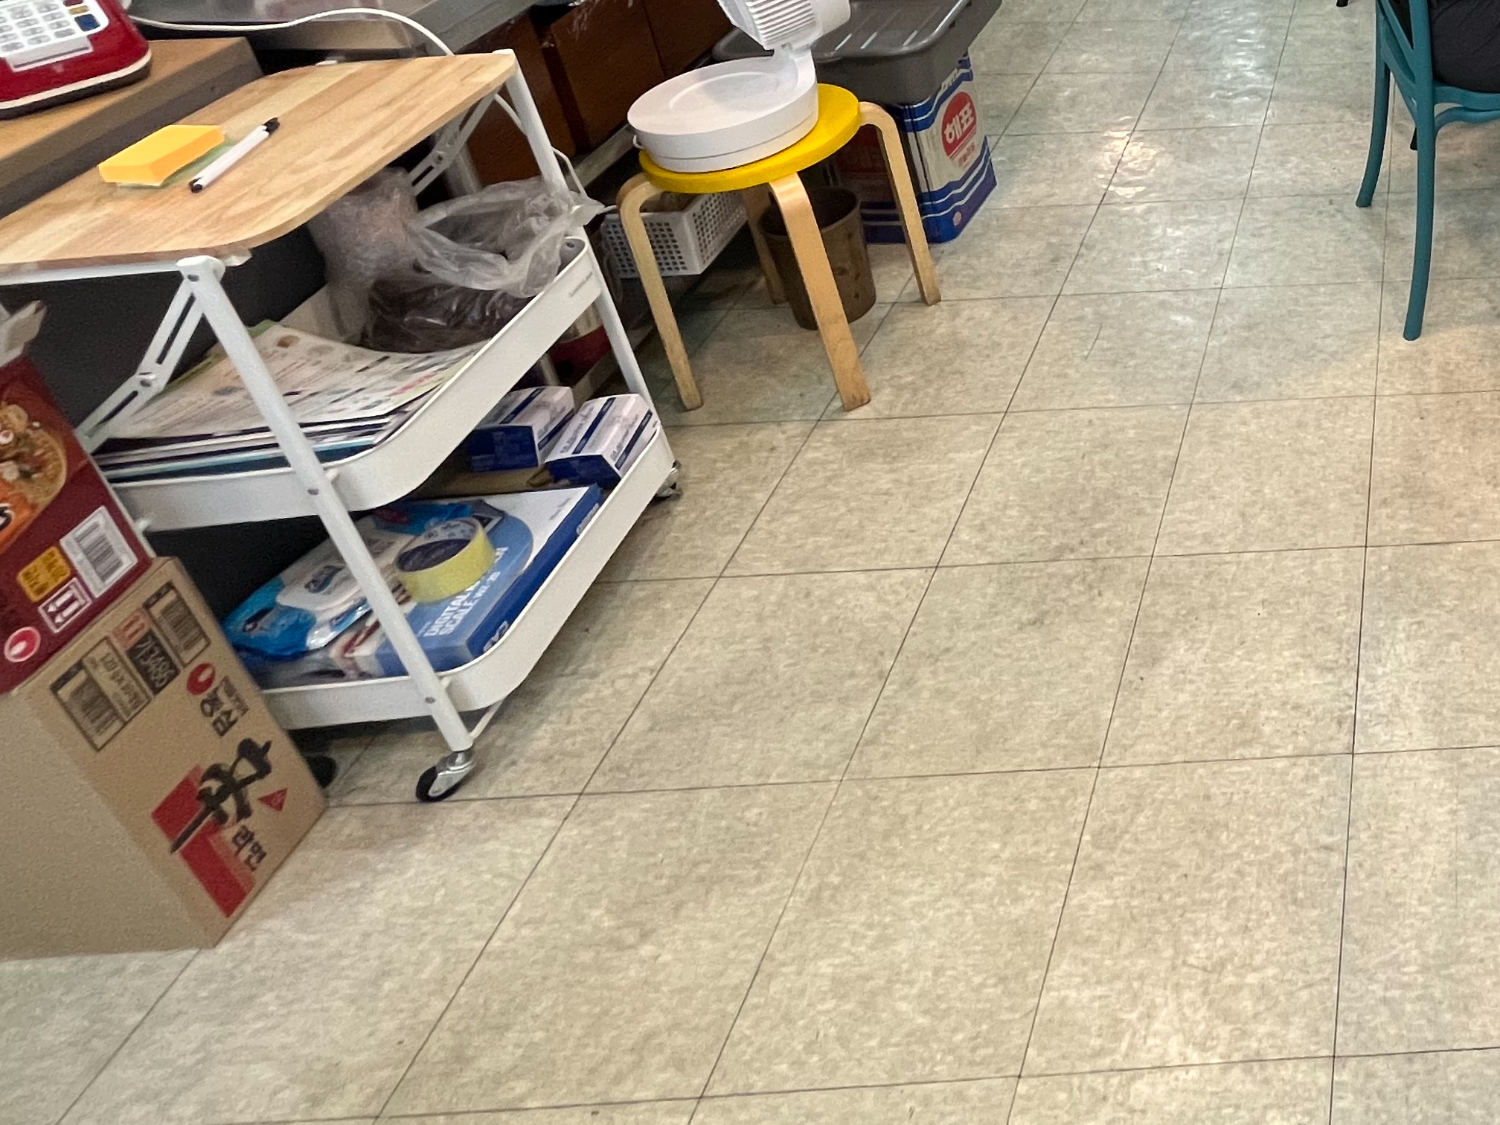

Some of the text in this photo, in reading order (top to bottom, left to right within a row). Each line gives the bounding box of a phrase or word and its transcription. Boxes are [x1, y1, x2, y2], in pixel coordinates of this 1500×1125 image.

[944, 102, 975, 144] 해표
[438, 599, 476, 636] SCALE
[200, 689, 239, 737] 농심
[232, 825, 267, 872] 라면
